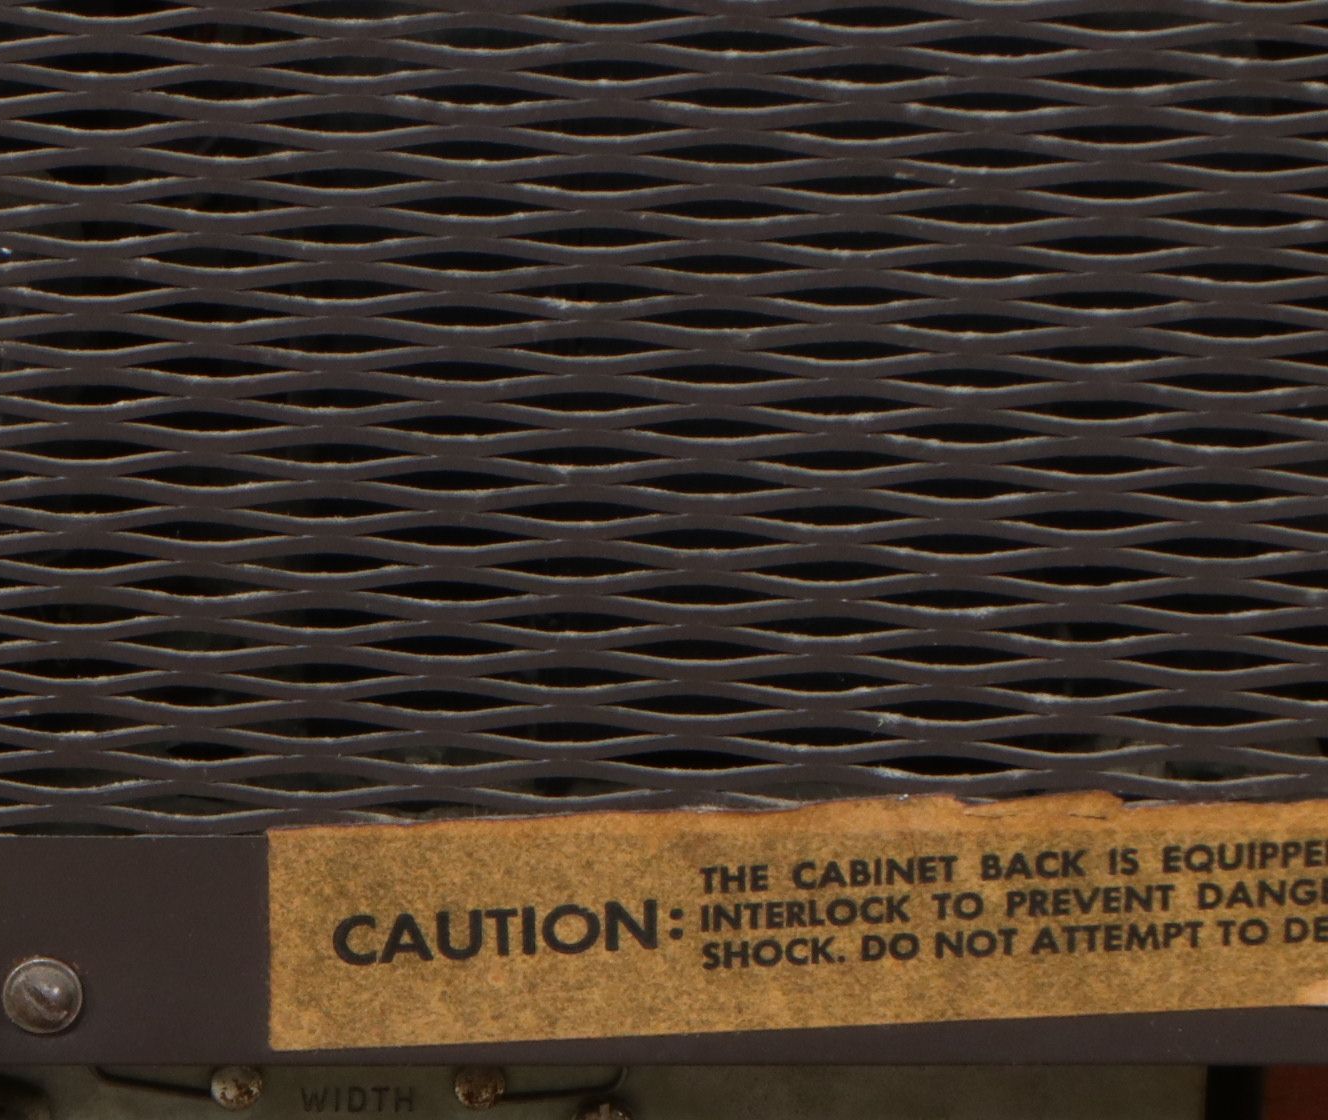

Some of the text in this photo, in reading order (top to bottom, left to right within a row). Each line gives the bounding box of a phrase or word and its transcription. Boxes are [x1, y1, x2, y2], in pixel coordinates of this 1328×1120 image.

[699, 839, 1328, 894] THE CABINET BACK IS EQUIPPE
[332, 898, 685, 967] CAUTION:
[699, 894, 912, 933] INTERLOCK
[930, 890, 986, 921] TO
[1005, 883, 1177, 918] PREVENT
[700, 935, 847, 971] SHOCK.
[859, 931, 921, 962] DO
[934, 926, 1019, 960] NOT
[1030, 920, 1205, 955] ATTEMPT
[1216, 917, 1270, 947] TO
[300, 1085, 415, 1113] WIDTH
